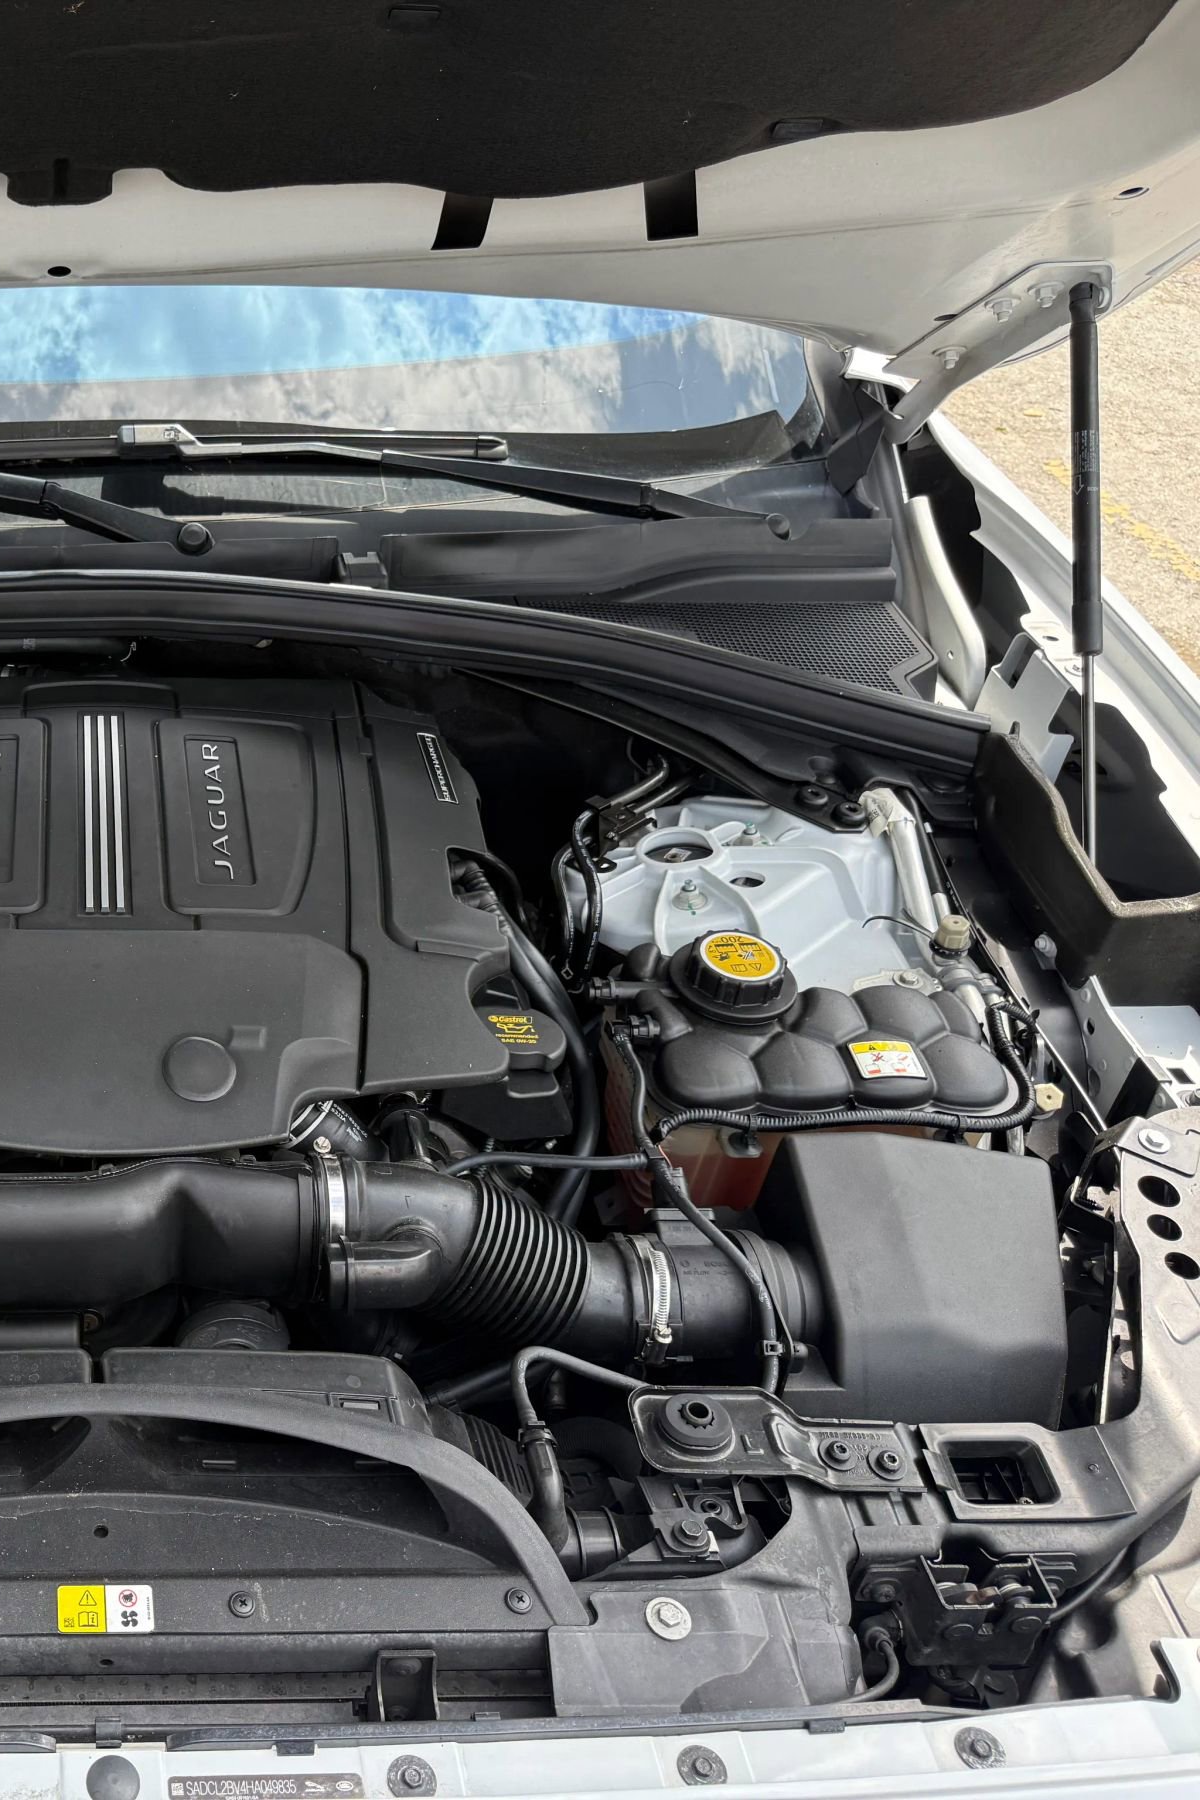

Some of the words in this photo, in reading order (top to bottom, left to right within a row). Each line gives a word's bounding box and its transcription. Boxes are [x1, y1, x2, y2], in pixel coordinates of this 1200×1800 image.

[202, 743, 234, 880] JAGUAR
[498, 1015, 528, 1024] Castrol
[185, 1779, 297, 1796] SADCL2BV4HA049835
